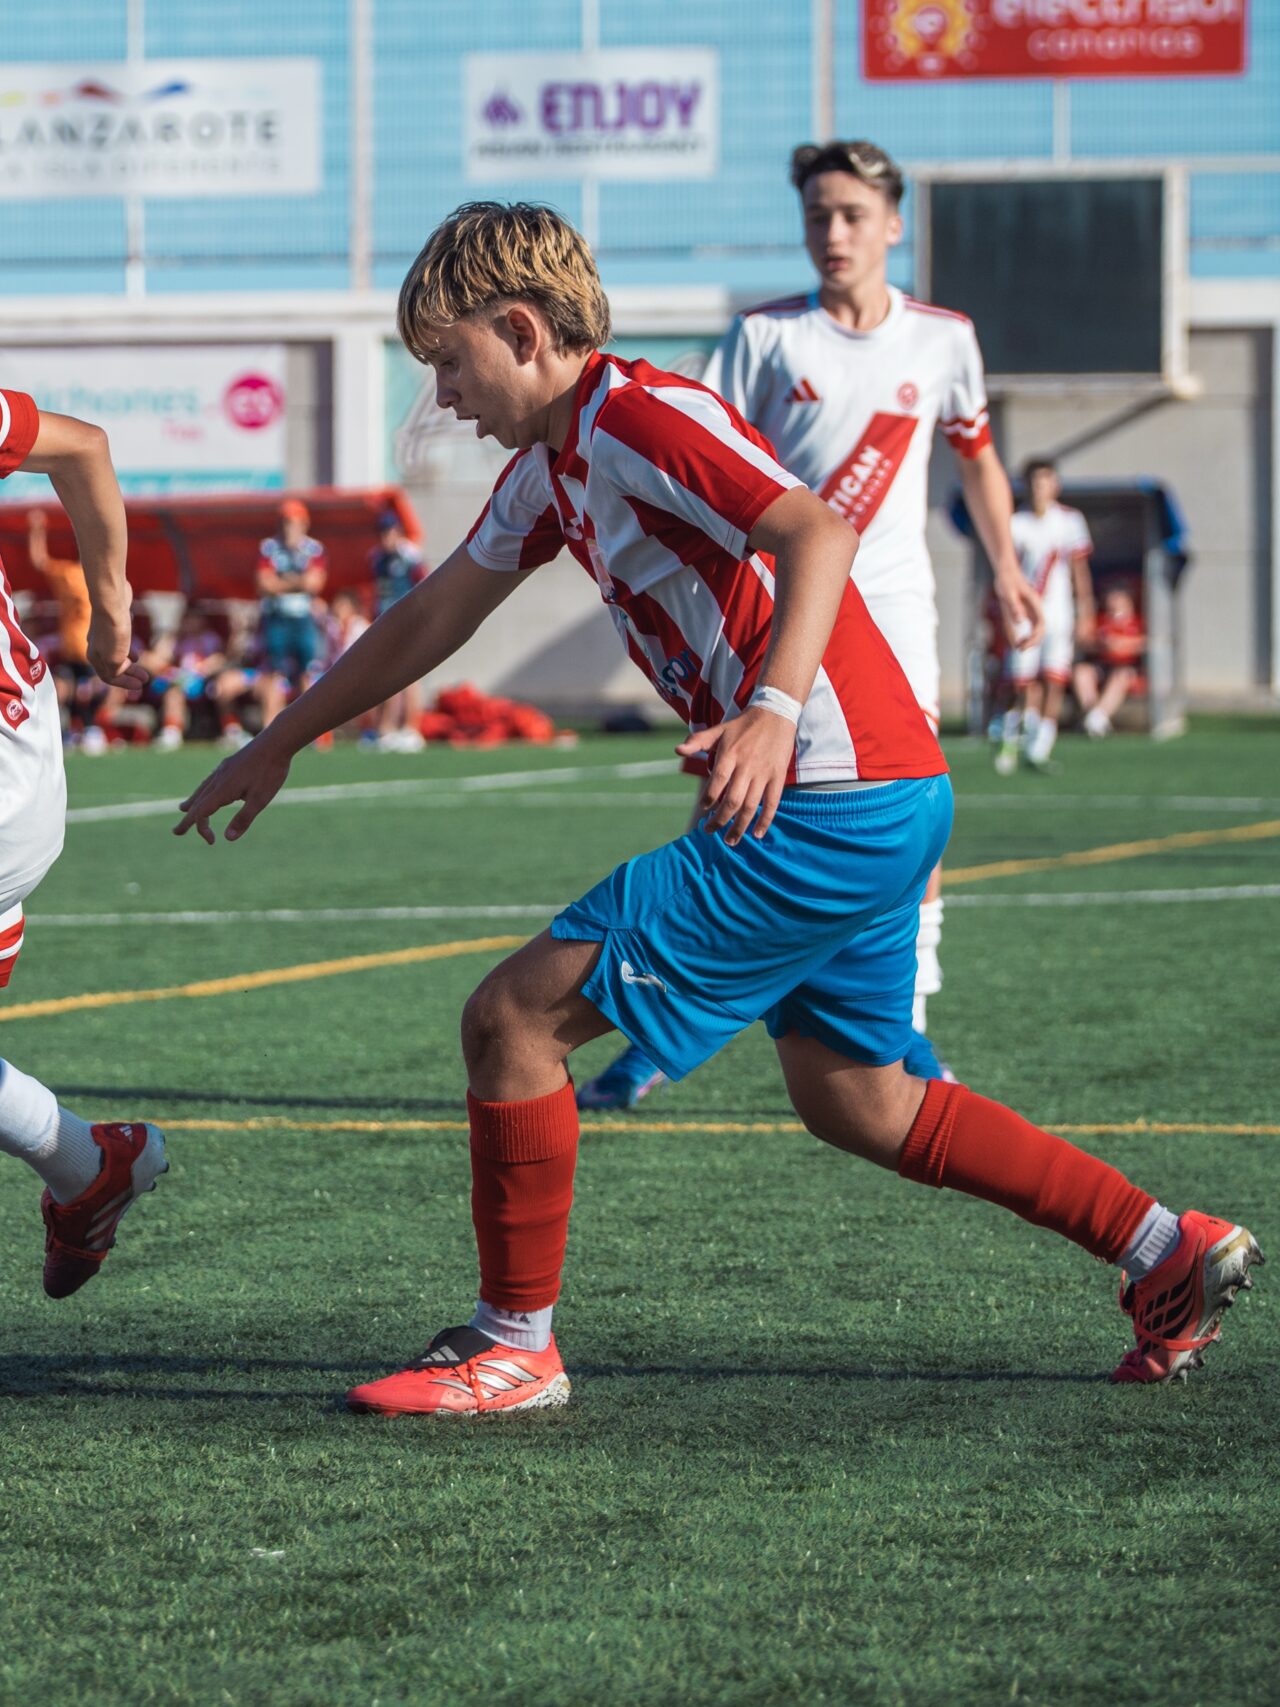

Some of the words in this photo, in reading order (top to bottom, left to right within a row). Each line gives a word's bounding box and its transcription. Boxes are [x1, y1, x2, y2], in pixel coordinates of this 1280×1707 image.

[1029, 28, 1201, 60] canarias
[541, 79, 702, 134] ENJOY
[827, 444, 884, 516] TICAN
